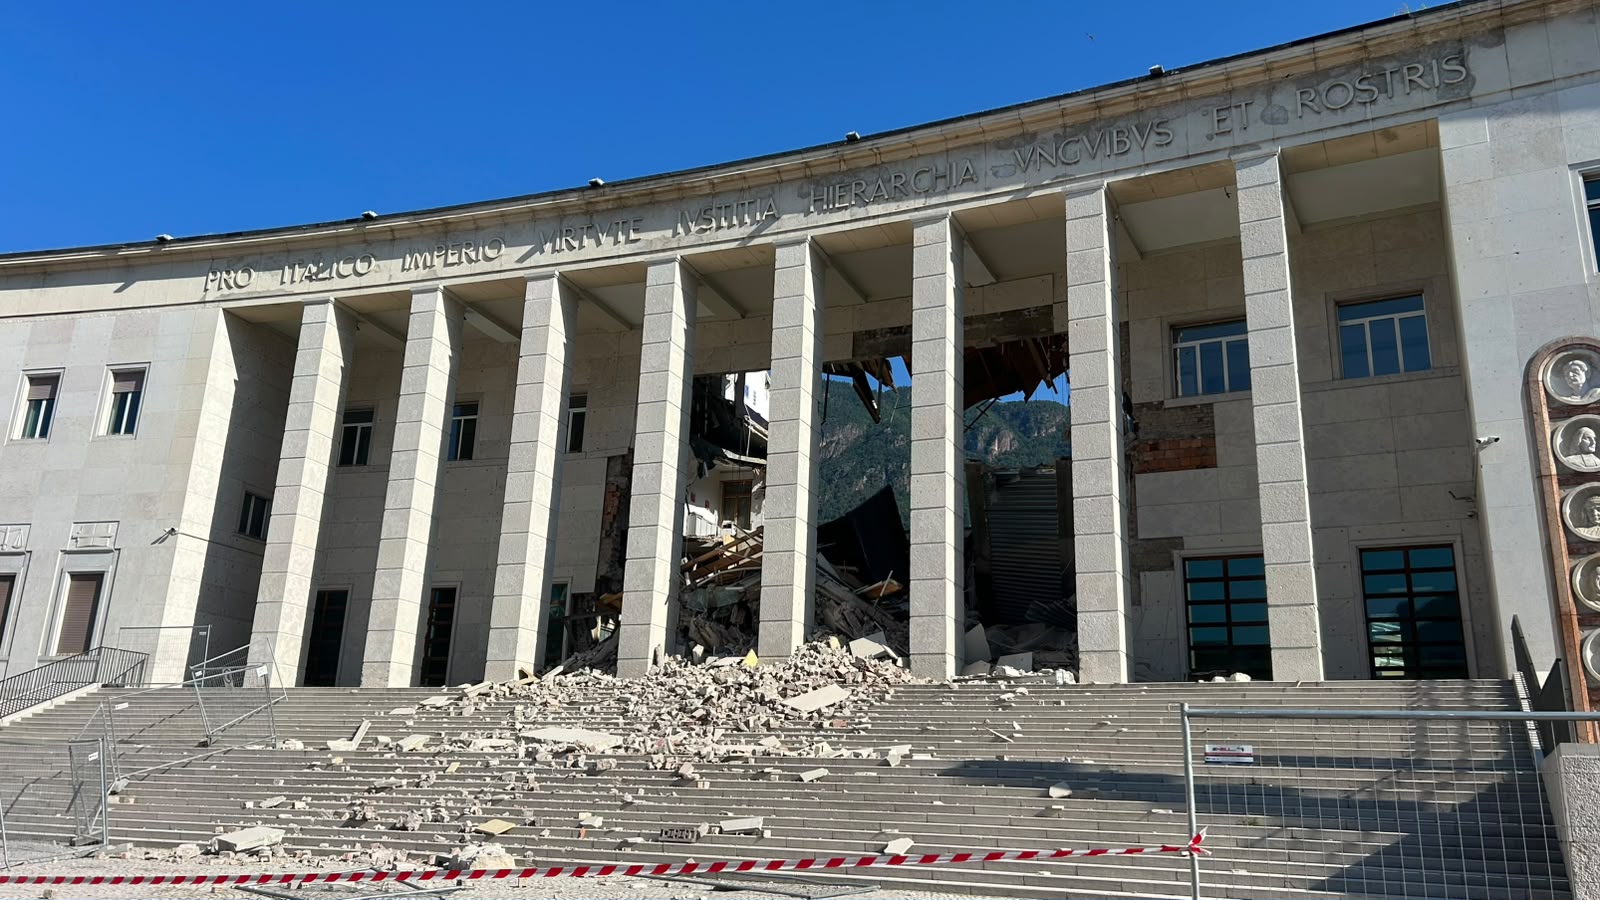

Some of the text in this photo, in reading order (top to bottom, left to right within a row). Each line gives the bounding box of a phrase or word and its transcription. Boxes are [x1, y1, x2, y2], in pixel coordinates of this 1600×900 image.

[205, 54, 1468, 291] PRO ITALICO IMPERIO VIRTVTE IVSTITIA HIERARCHIA VNGVIBVS ET ROSTRIS
